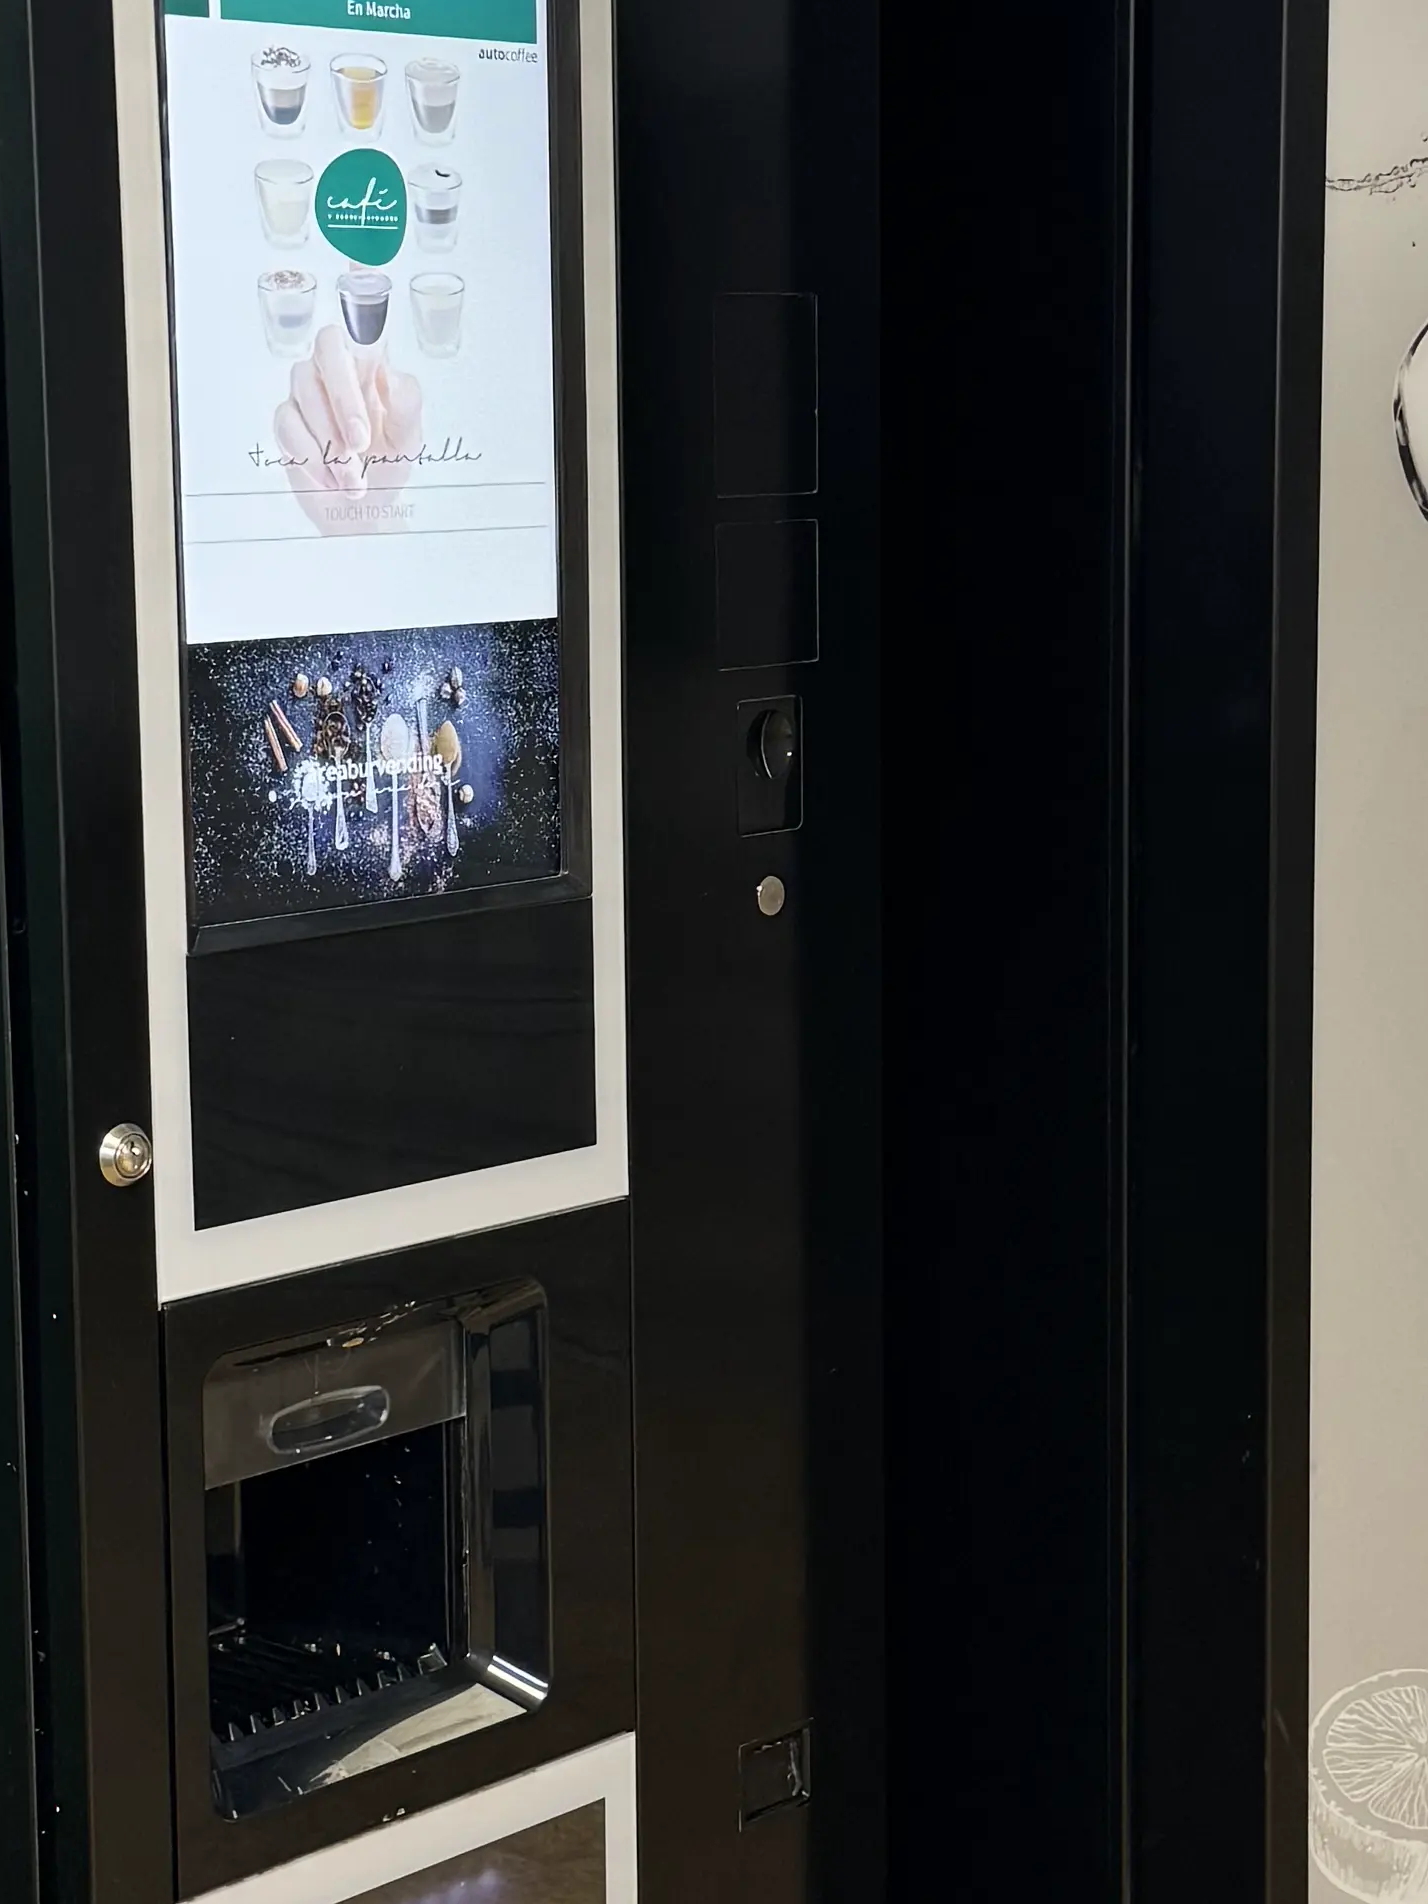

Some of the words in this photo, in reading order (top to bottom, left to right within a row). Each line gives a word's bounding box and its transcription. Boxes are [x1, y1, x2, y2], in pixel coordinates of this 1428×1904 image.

[347, 0, 364, 16] En
[366, 0, 412, 20] Marcha
[478, 47, 539, 64] autocoffee
[324, 505, 364, 522] TOUCH
[365, 504, 380, 521] TO
[381, 502, 415, 520] START
